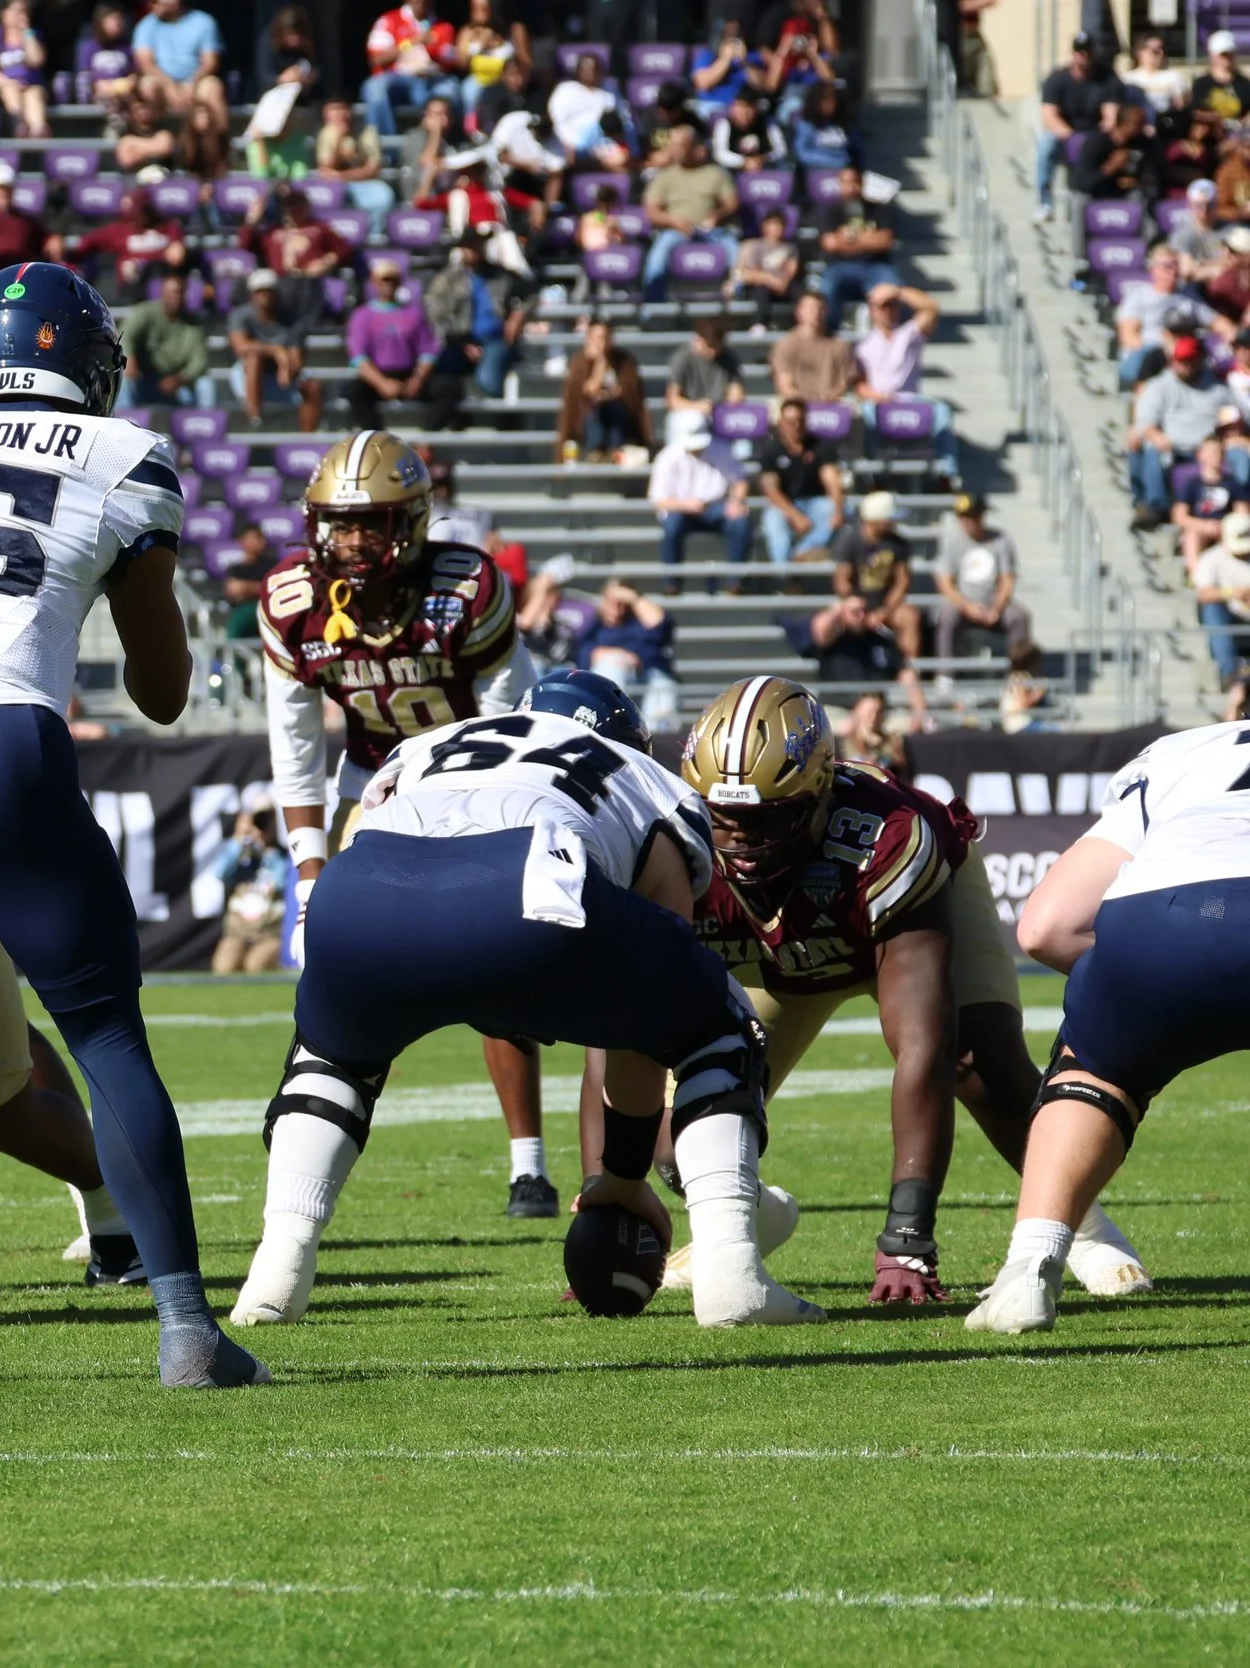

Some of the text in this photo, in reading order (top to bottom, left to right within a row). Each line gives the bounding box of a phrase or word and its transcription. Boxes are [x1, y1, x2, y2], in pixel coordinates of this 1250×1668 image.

[6, 286, 24, 295] C2P
[35, 422, 82, 460] JR
[317, 655, 454, 687] TEXAS STATE
[348, 686, 457, 737] 10
[417, 714, 628, 816] 64
[717, 789, 750, 799] BOBCATS
[823, 807, 885, 871] 13
